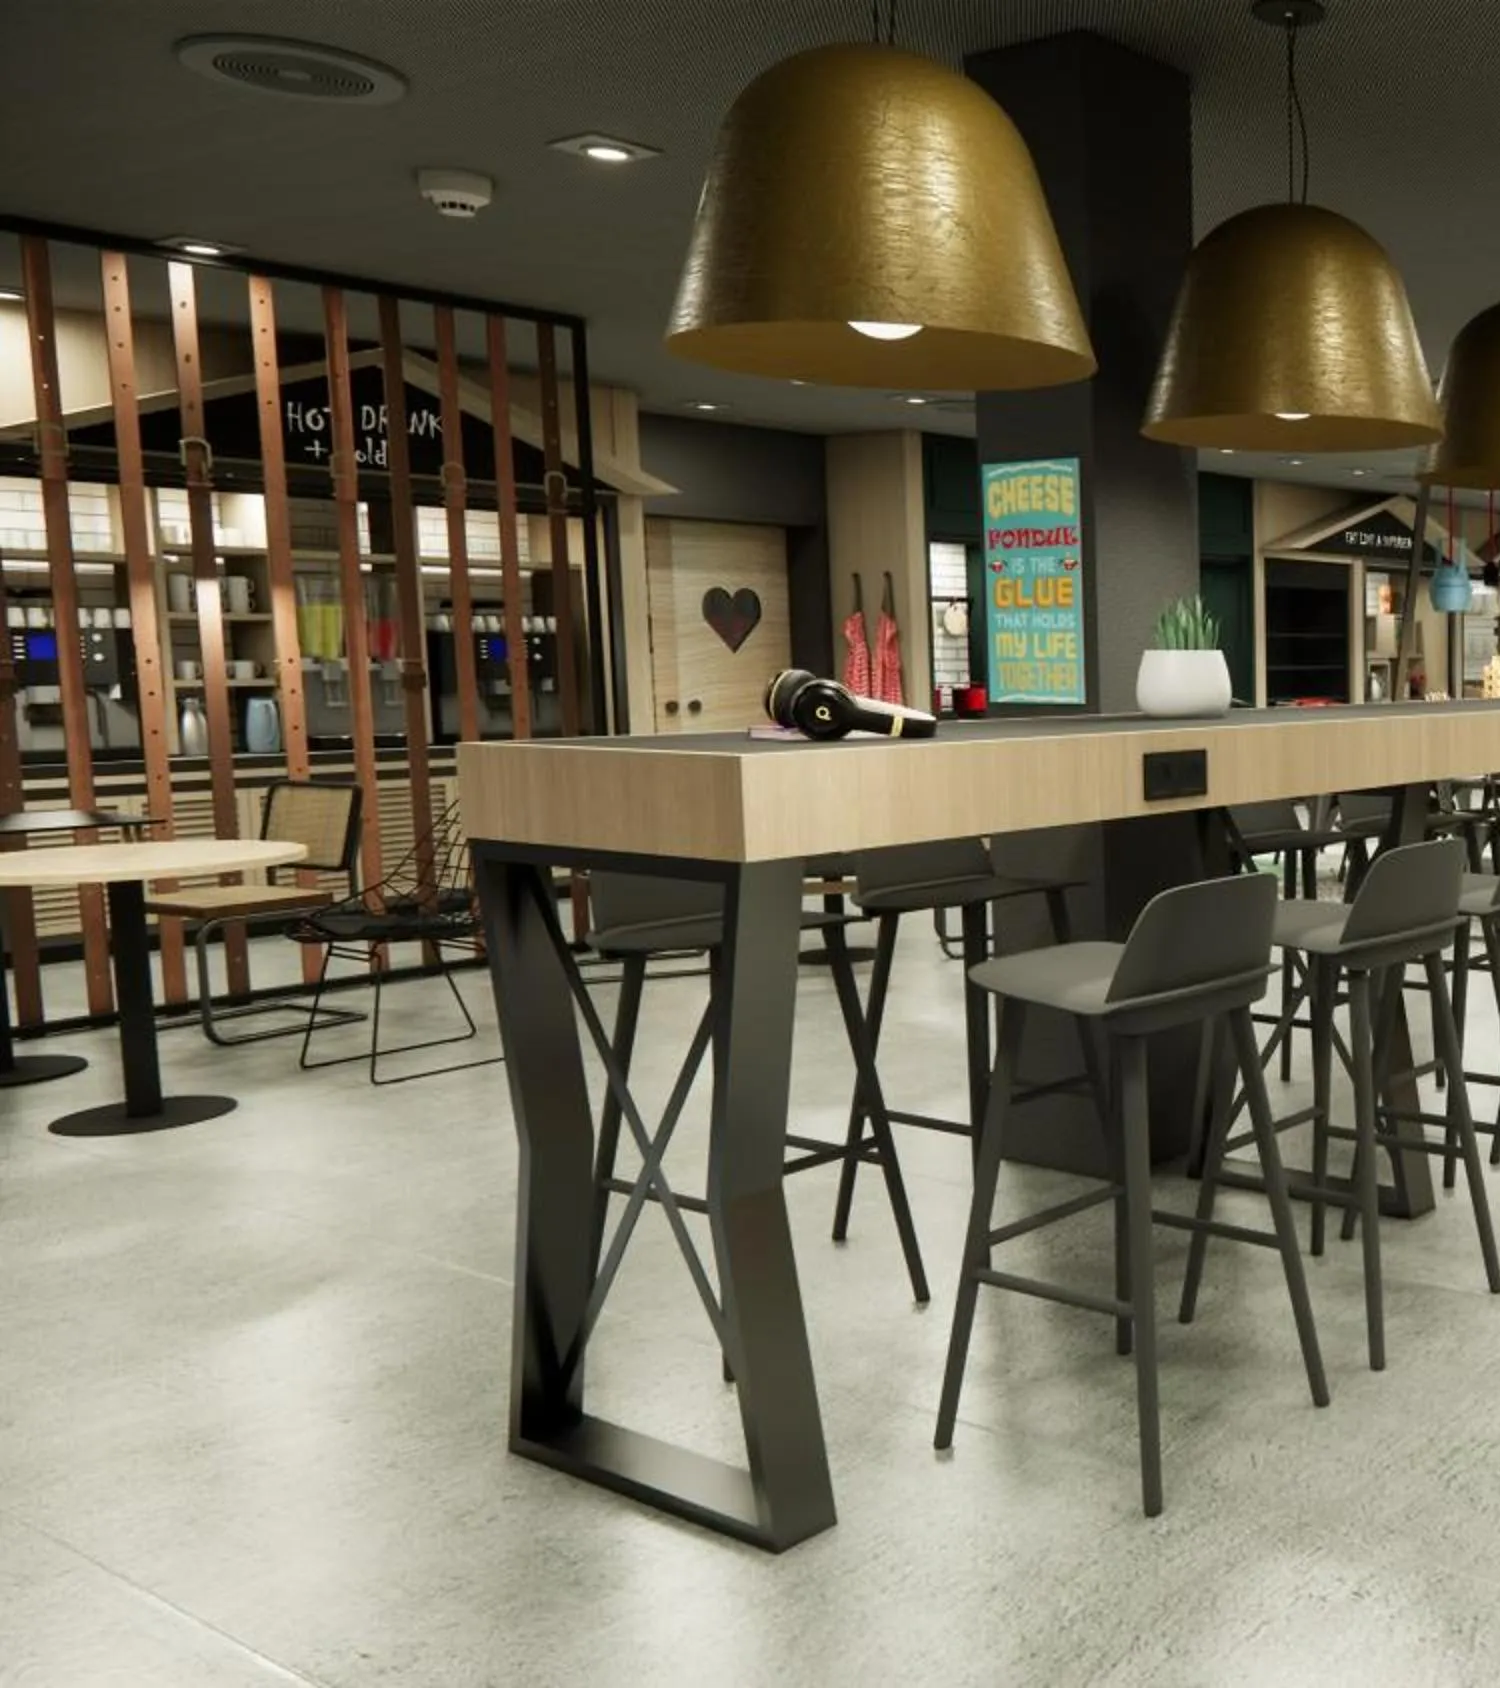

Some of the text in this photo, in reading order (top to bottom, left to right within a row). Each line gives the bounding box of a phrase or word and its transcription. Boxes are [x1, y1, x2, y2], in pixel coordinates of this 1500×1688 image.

[987, 474, 1075, 520] CHEESE
[988, 526, 1078, 550] FONDUE
[1011, 556, 1057, 574] IS THE
[994, 575, 1074, 609] GLUE
[996, 611, 1076, 629] THAT HOLDS
[995, 632, 1077, 658] MY LIFE
